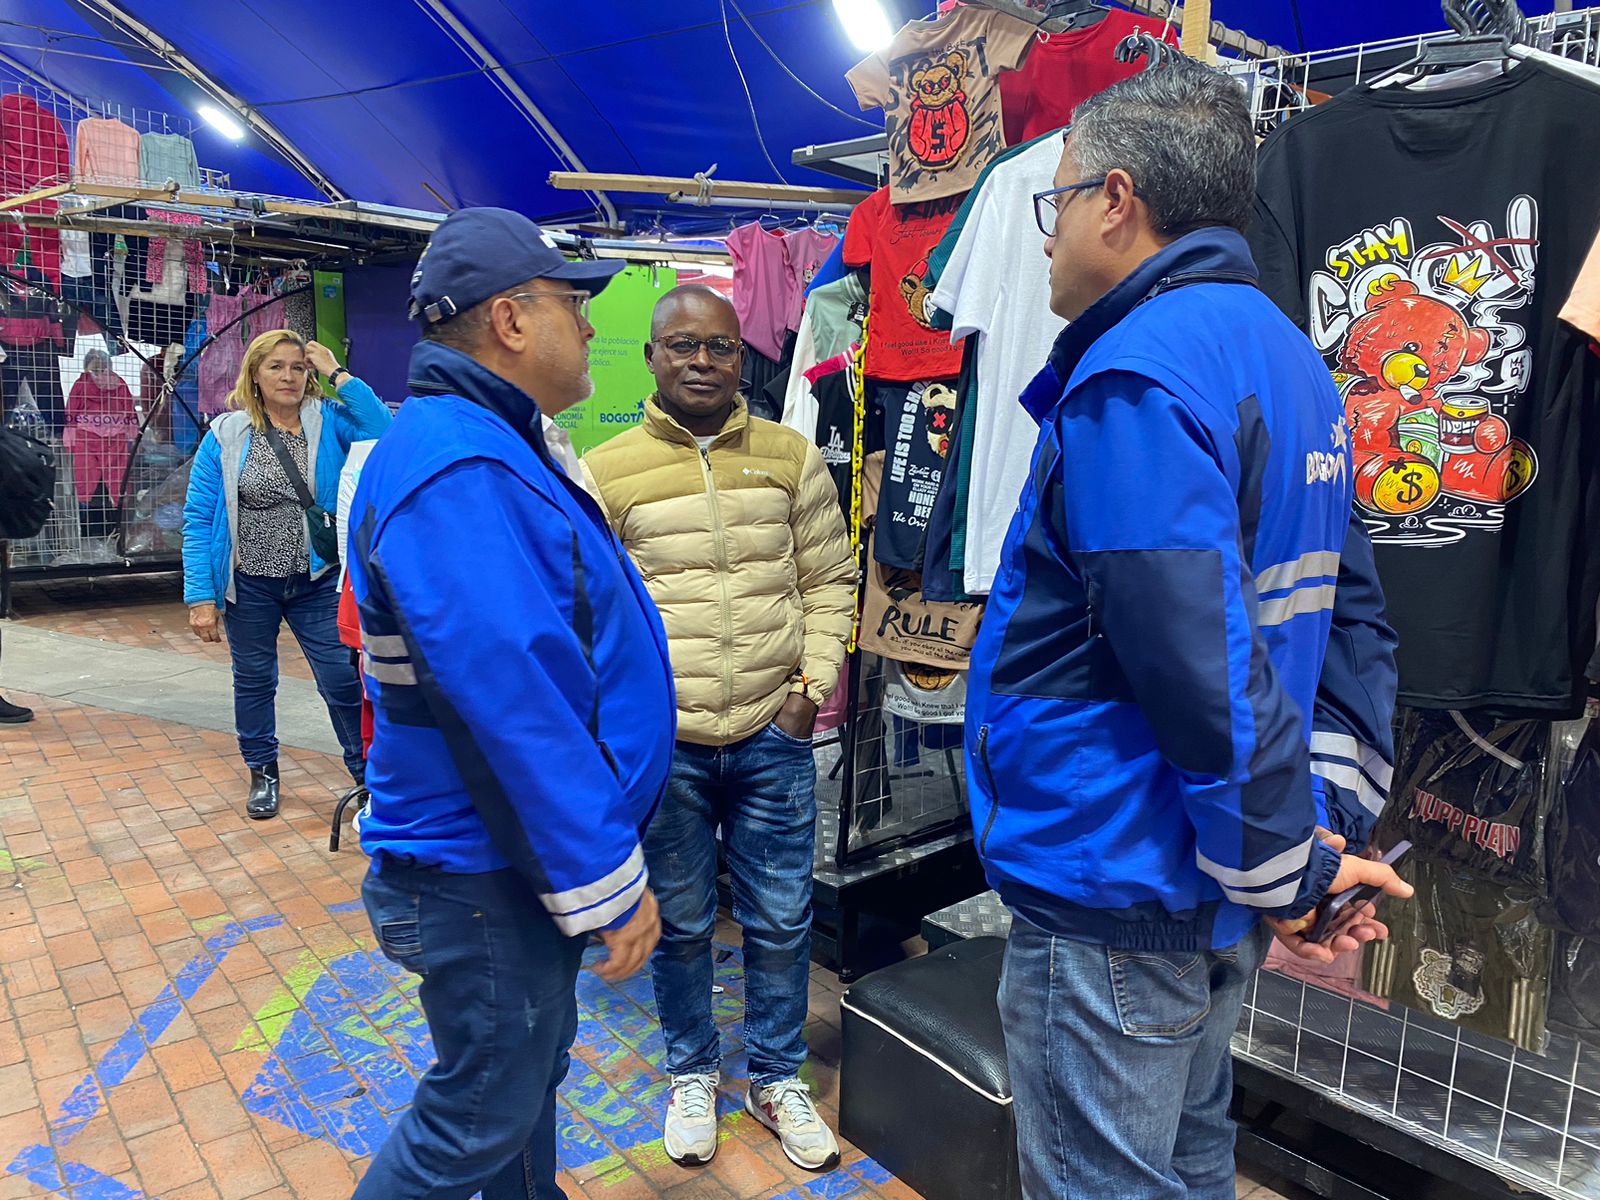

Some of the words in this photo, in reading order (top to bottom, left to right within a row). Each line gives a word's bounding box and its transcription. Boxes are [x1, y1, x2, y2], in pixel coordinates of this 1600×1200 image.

[1328, 218, 1411, 279] STAY
[828, 425, 845, 453] LA
[897, 413, 916, 441] TOO
[890, 455, 908, 484] LIFE
[892, 510, 906, 523] The
[876, 605, 959, 641] RULE
[921, 709, 938, 717] good
